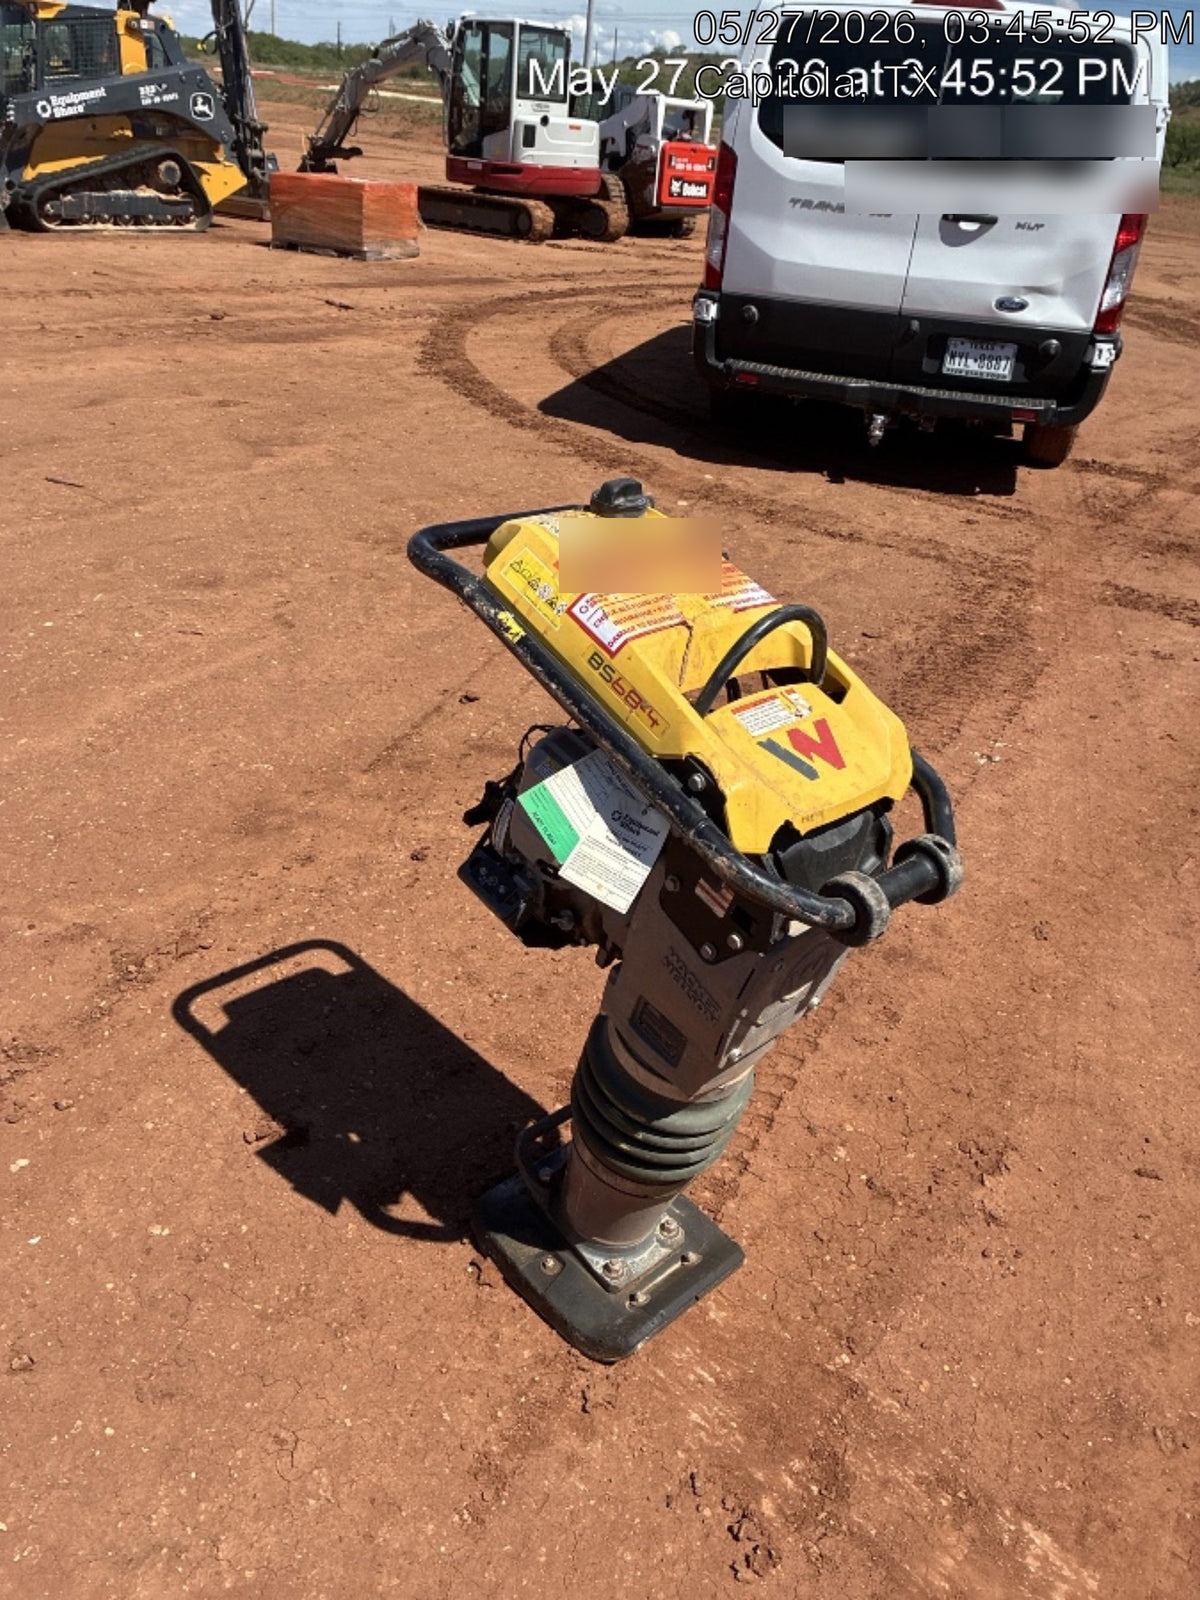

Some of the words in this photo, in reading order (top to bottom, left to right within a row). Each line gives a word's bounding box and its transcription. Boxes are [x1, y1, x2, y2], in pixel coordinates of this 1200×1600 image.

[50, 87, 106, 104] Equipment
[53, 104, 84, 118] Share
[682, 182, 707, 197] Bobcat
[789, 197, 845, 214] TRAN
[588, 650, 660, 728] BS68-4
